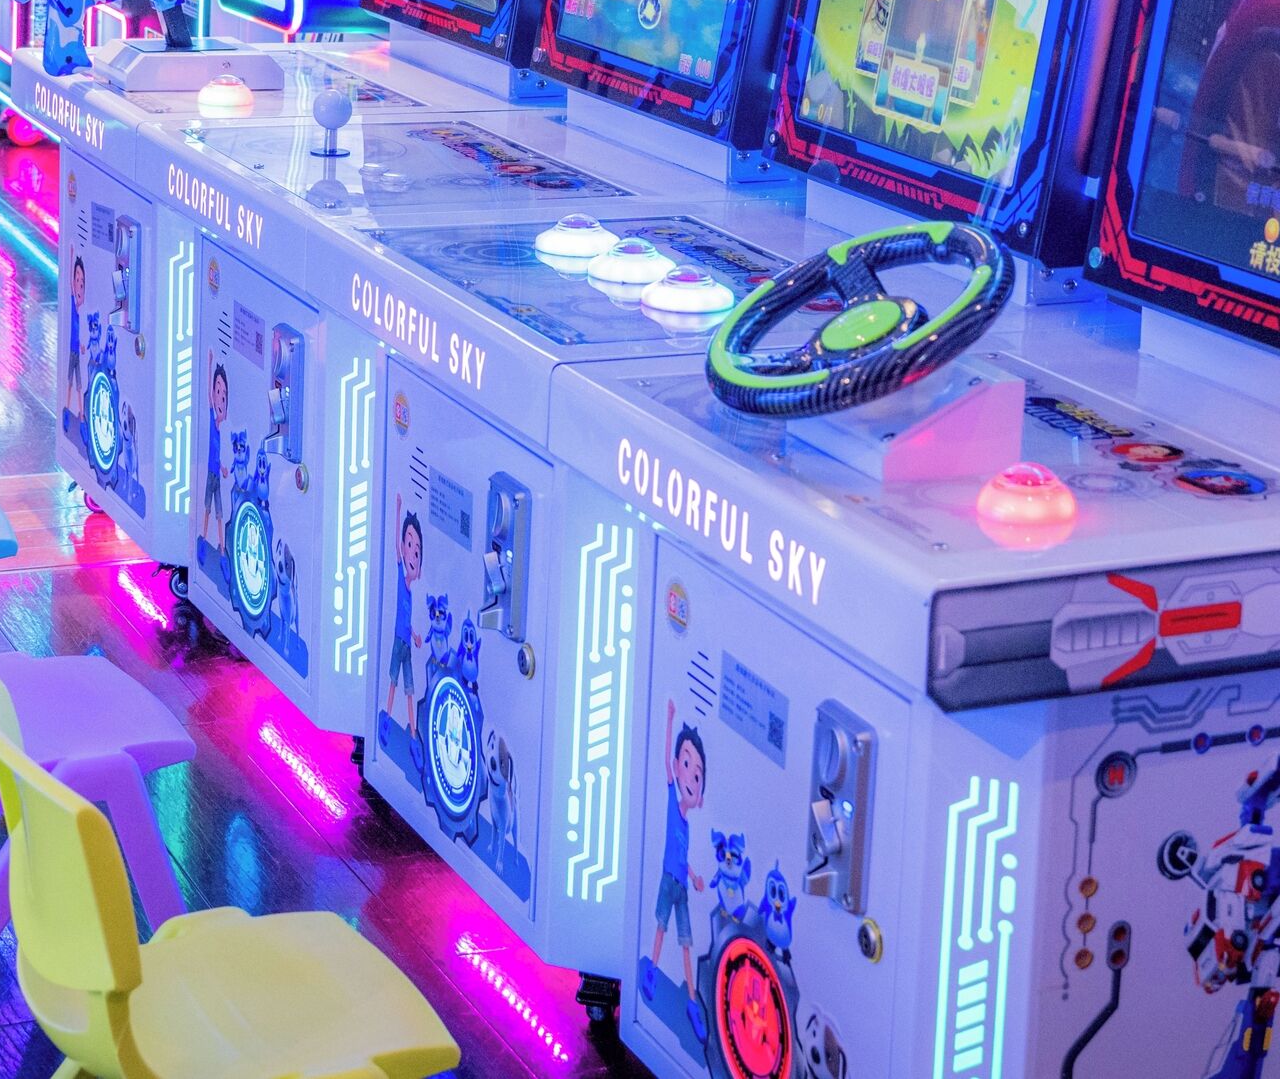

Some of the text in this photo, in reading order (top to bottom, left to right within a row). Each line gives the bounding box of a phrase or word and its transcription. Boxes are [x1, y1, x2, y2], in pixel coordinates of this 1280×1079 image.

[34, 82, 106, 151] COLORFUL SKY
[167, 163, 231, 231] COLORFUL
[237, 212, 264, 249] SKY
[351, 272, 440, 364] COLORFUL
[448, 331, 487, 391] SKY
[616, 437, 828, 607] COLORFUL SKY
